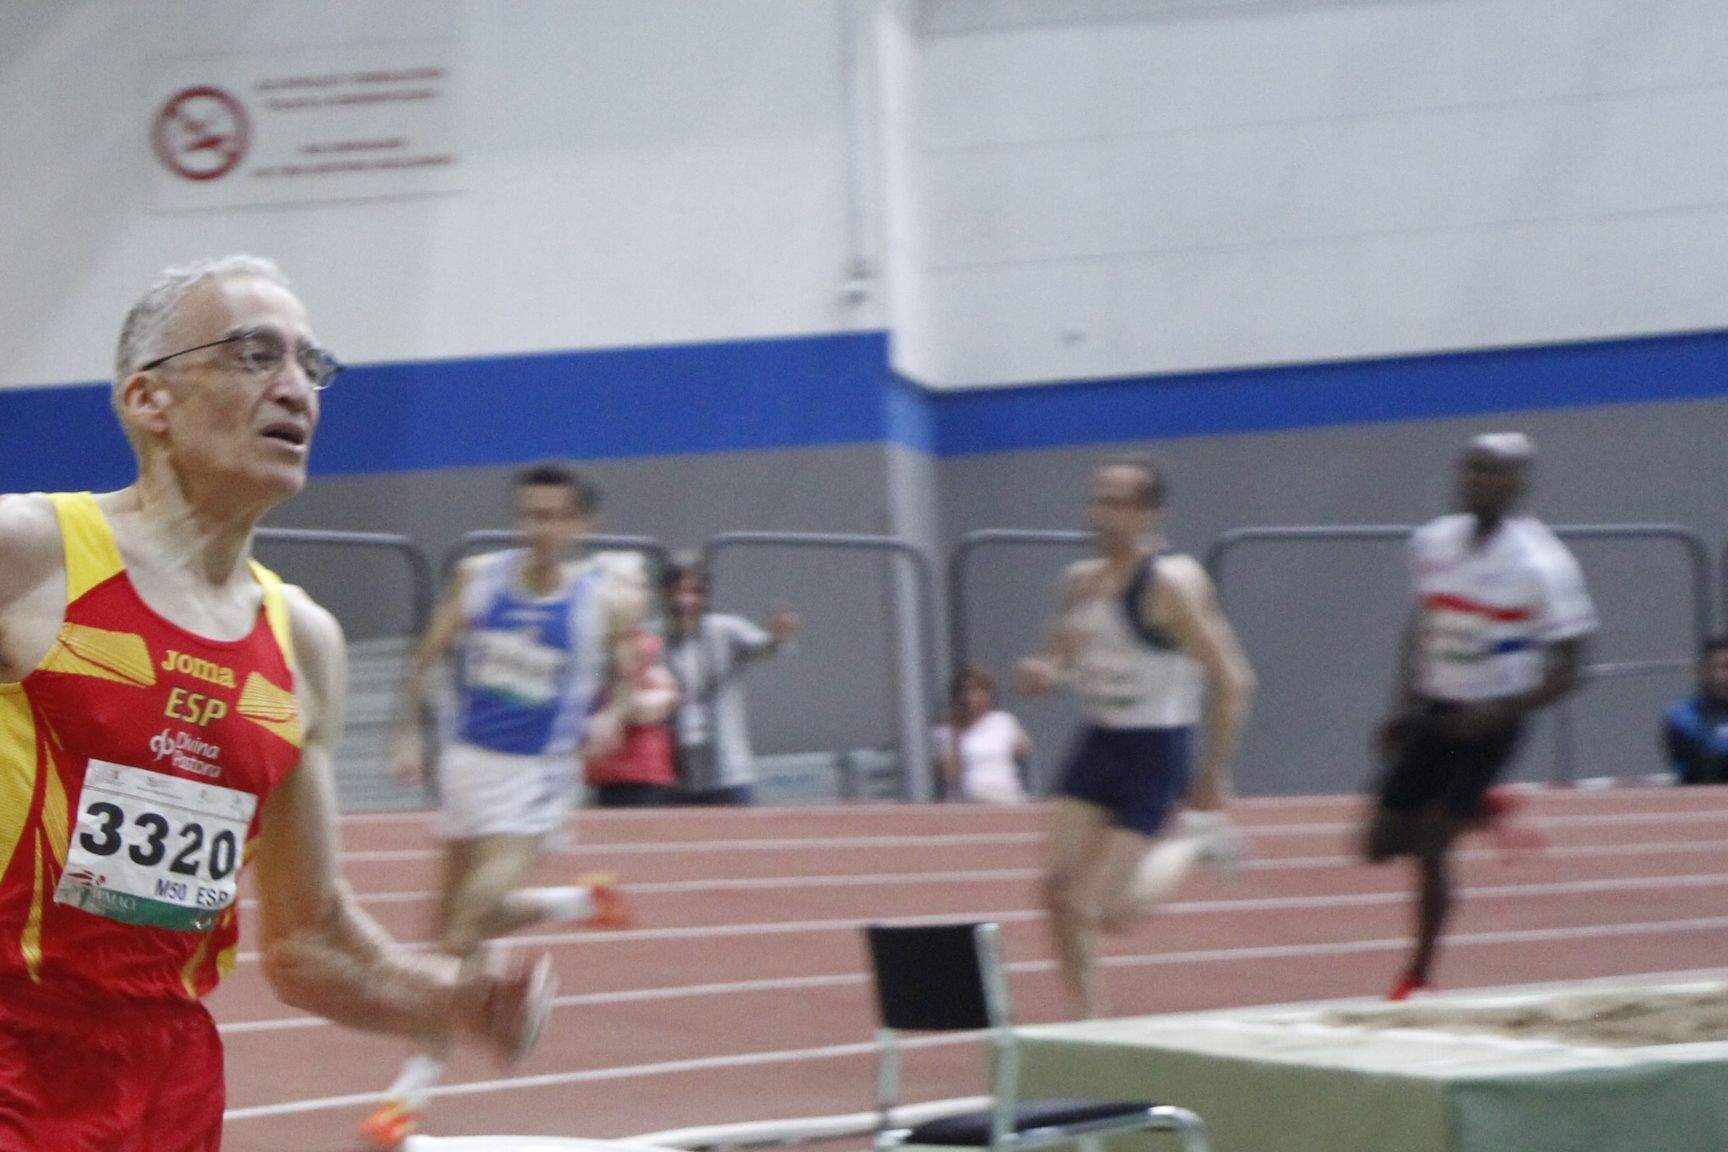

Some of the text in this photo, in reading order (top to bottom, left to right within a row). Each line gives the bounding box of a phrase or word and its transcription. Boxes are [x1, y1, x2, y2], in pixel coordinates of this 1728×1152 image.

[164, 686, 228, 727] ESP
[79, 801, 236, 880] 3320
[155, 878, 187, 901] M50
[196, 885, 229, 908] ESP
